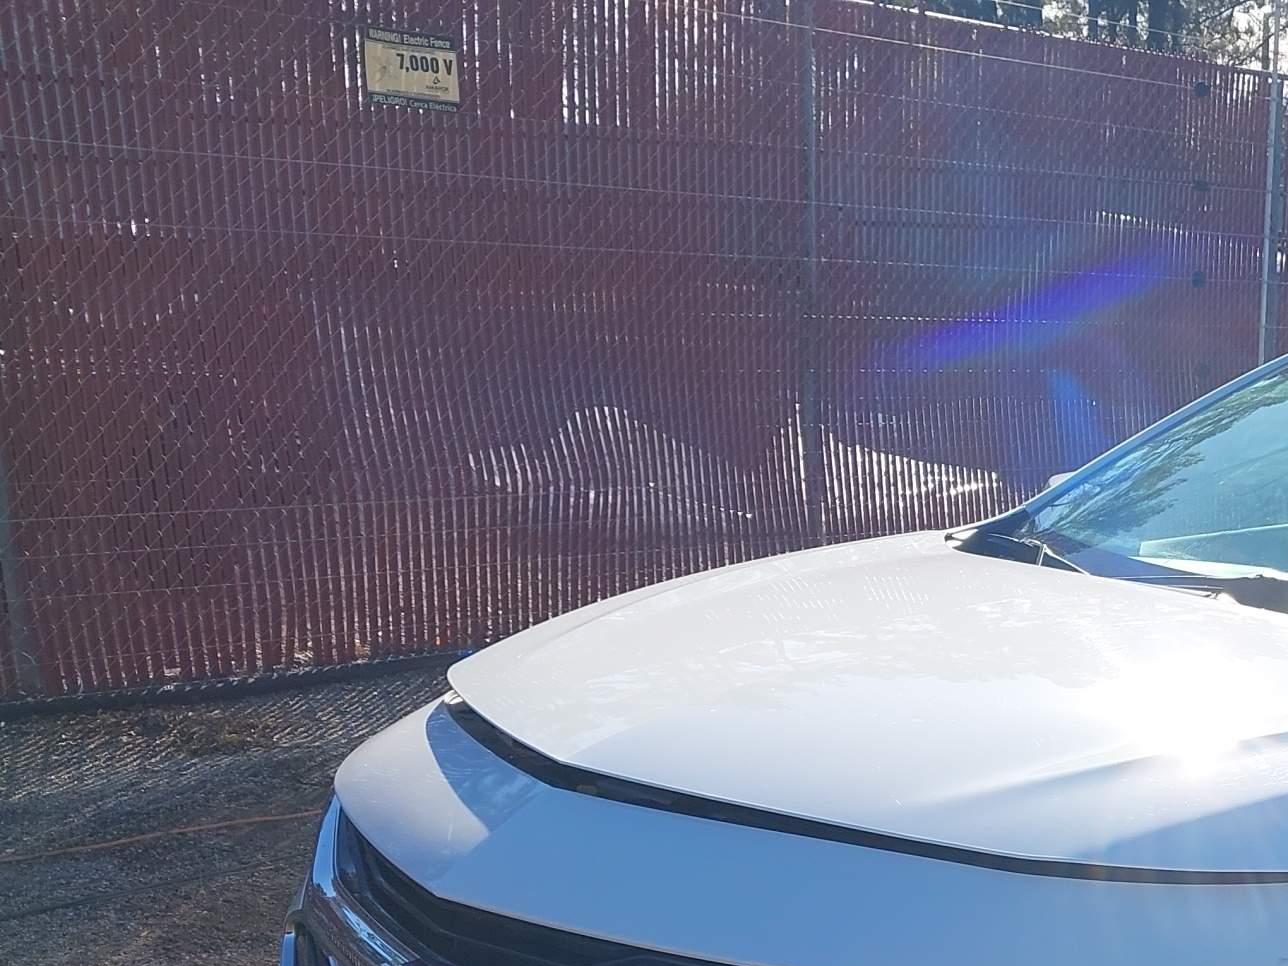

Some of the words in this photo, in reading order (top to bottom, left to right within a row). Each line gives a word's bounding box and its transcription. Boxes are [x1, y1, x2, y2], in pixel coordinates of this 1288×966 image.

[403, 34, 429, 47] Electric
[396, 52, 440, 75] 7,000
[443, 59, 453, 76] V
